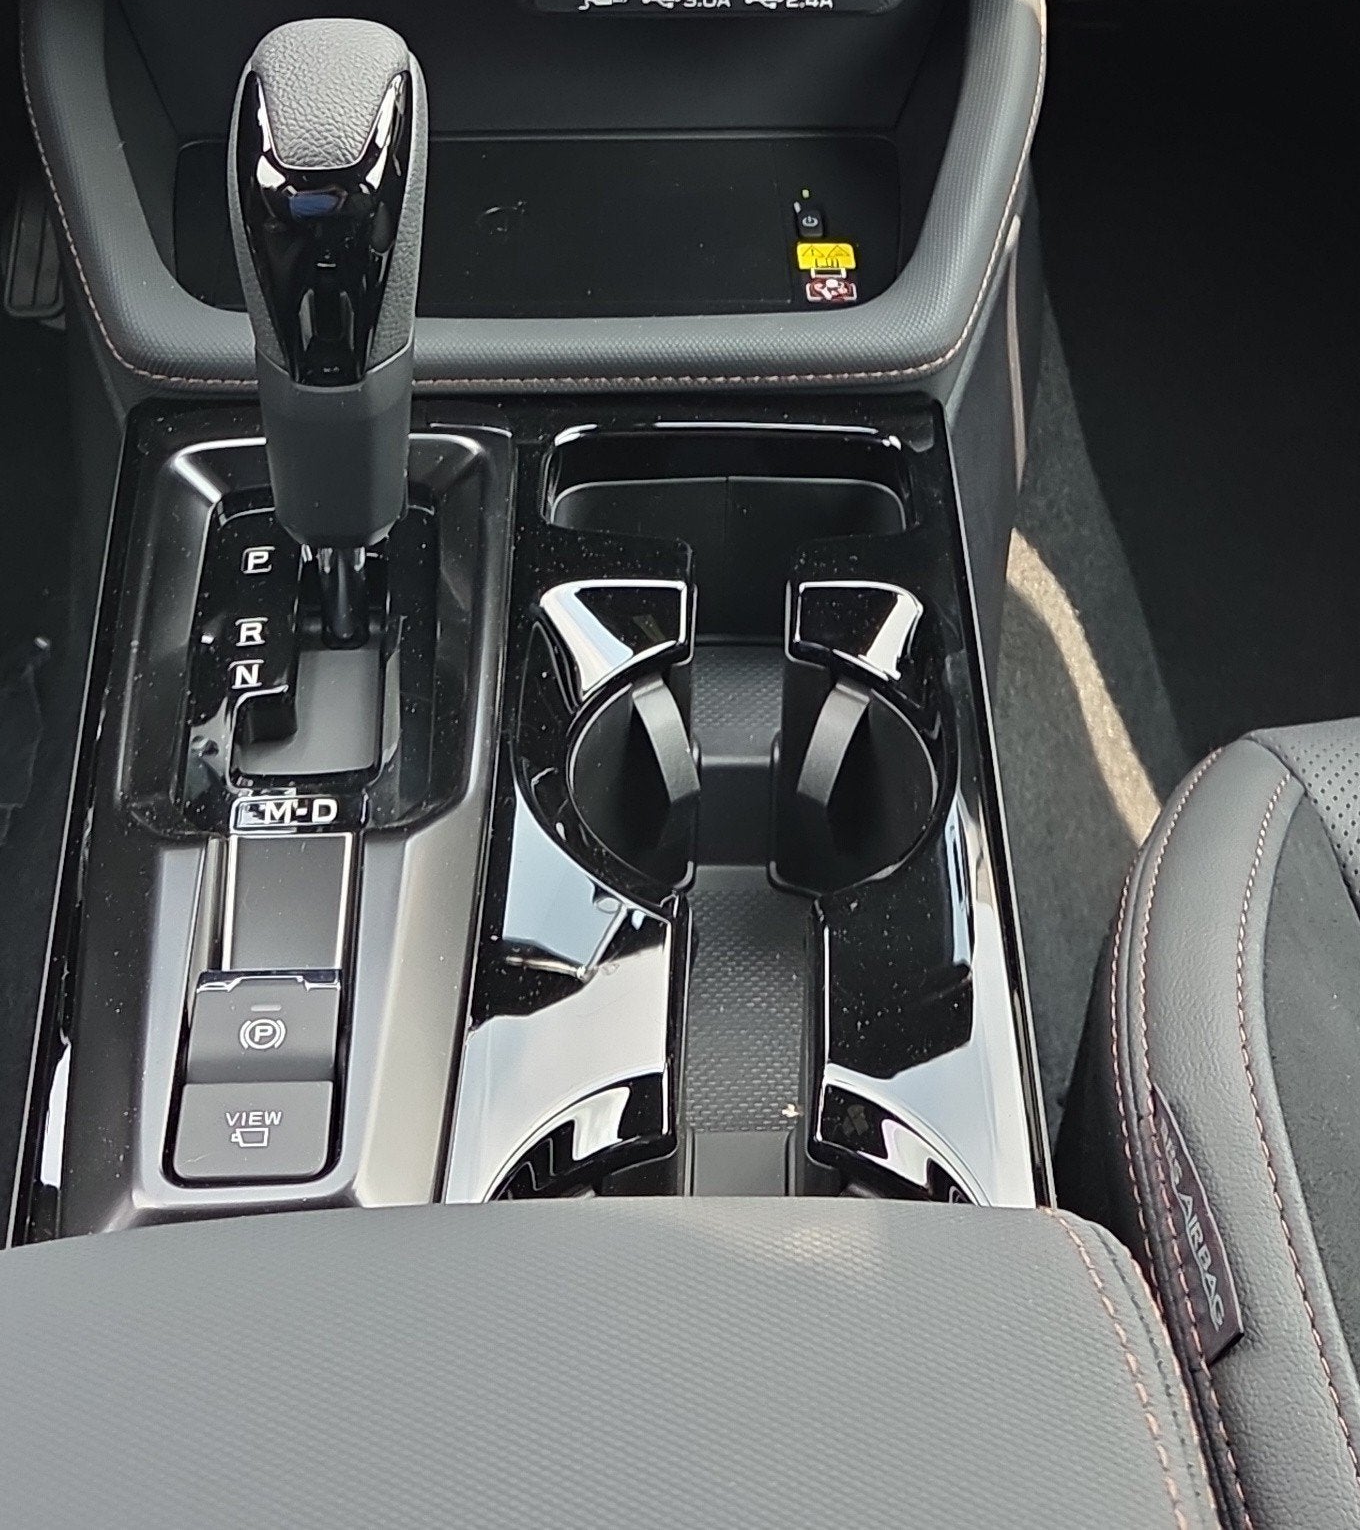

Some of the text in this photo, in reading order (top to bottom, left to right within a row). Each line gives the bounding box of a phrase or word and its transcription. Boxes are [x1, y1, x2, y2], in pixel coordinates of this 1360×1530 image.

[247, 551, 270, 571] P
[240, 622, 263, 644] R
[234, 664, 259, 686] N
[226, 1111, 282, 1127] VIEW
[1178, 1192, 1225, 1333] AIRBAG
